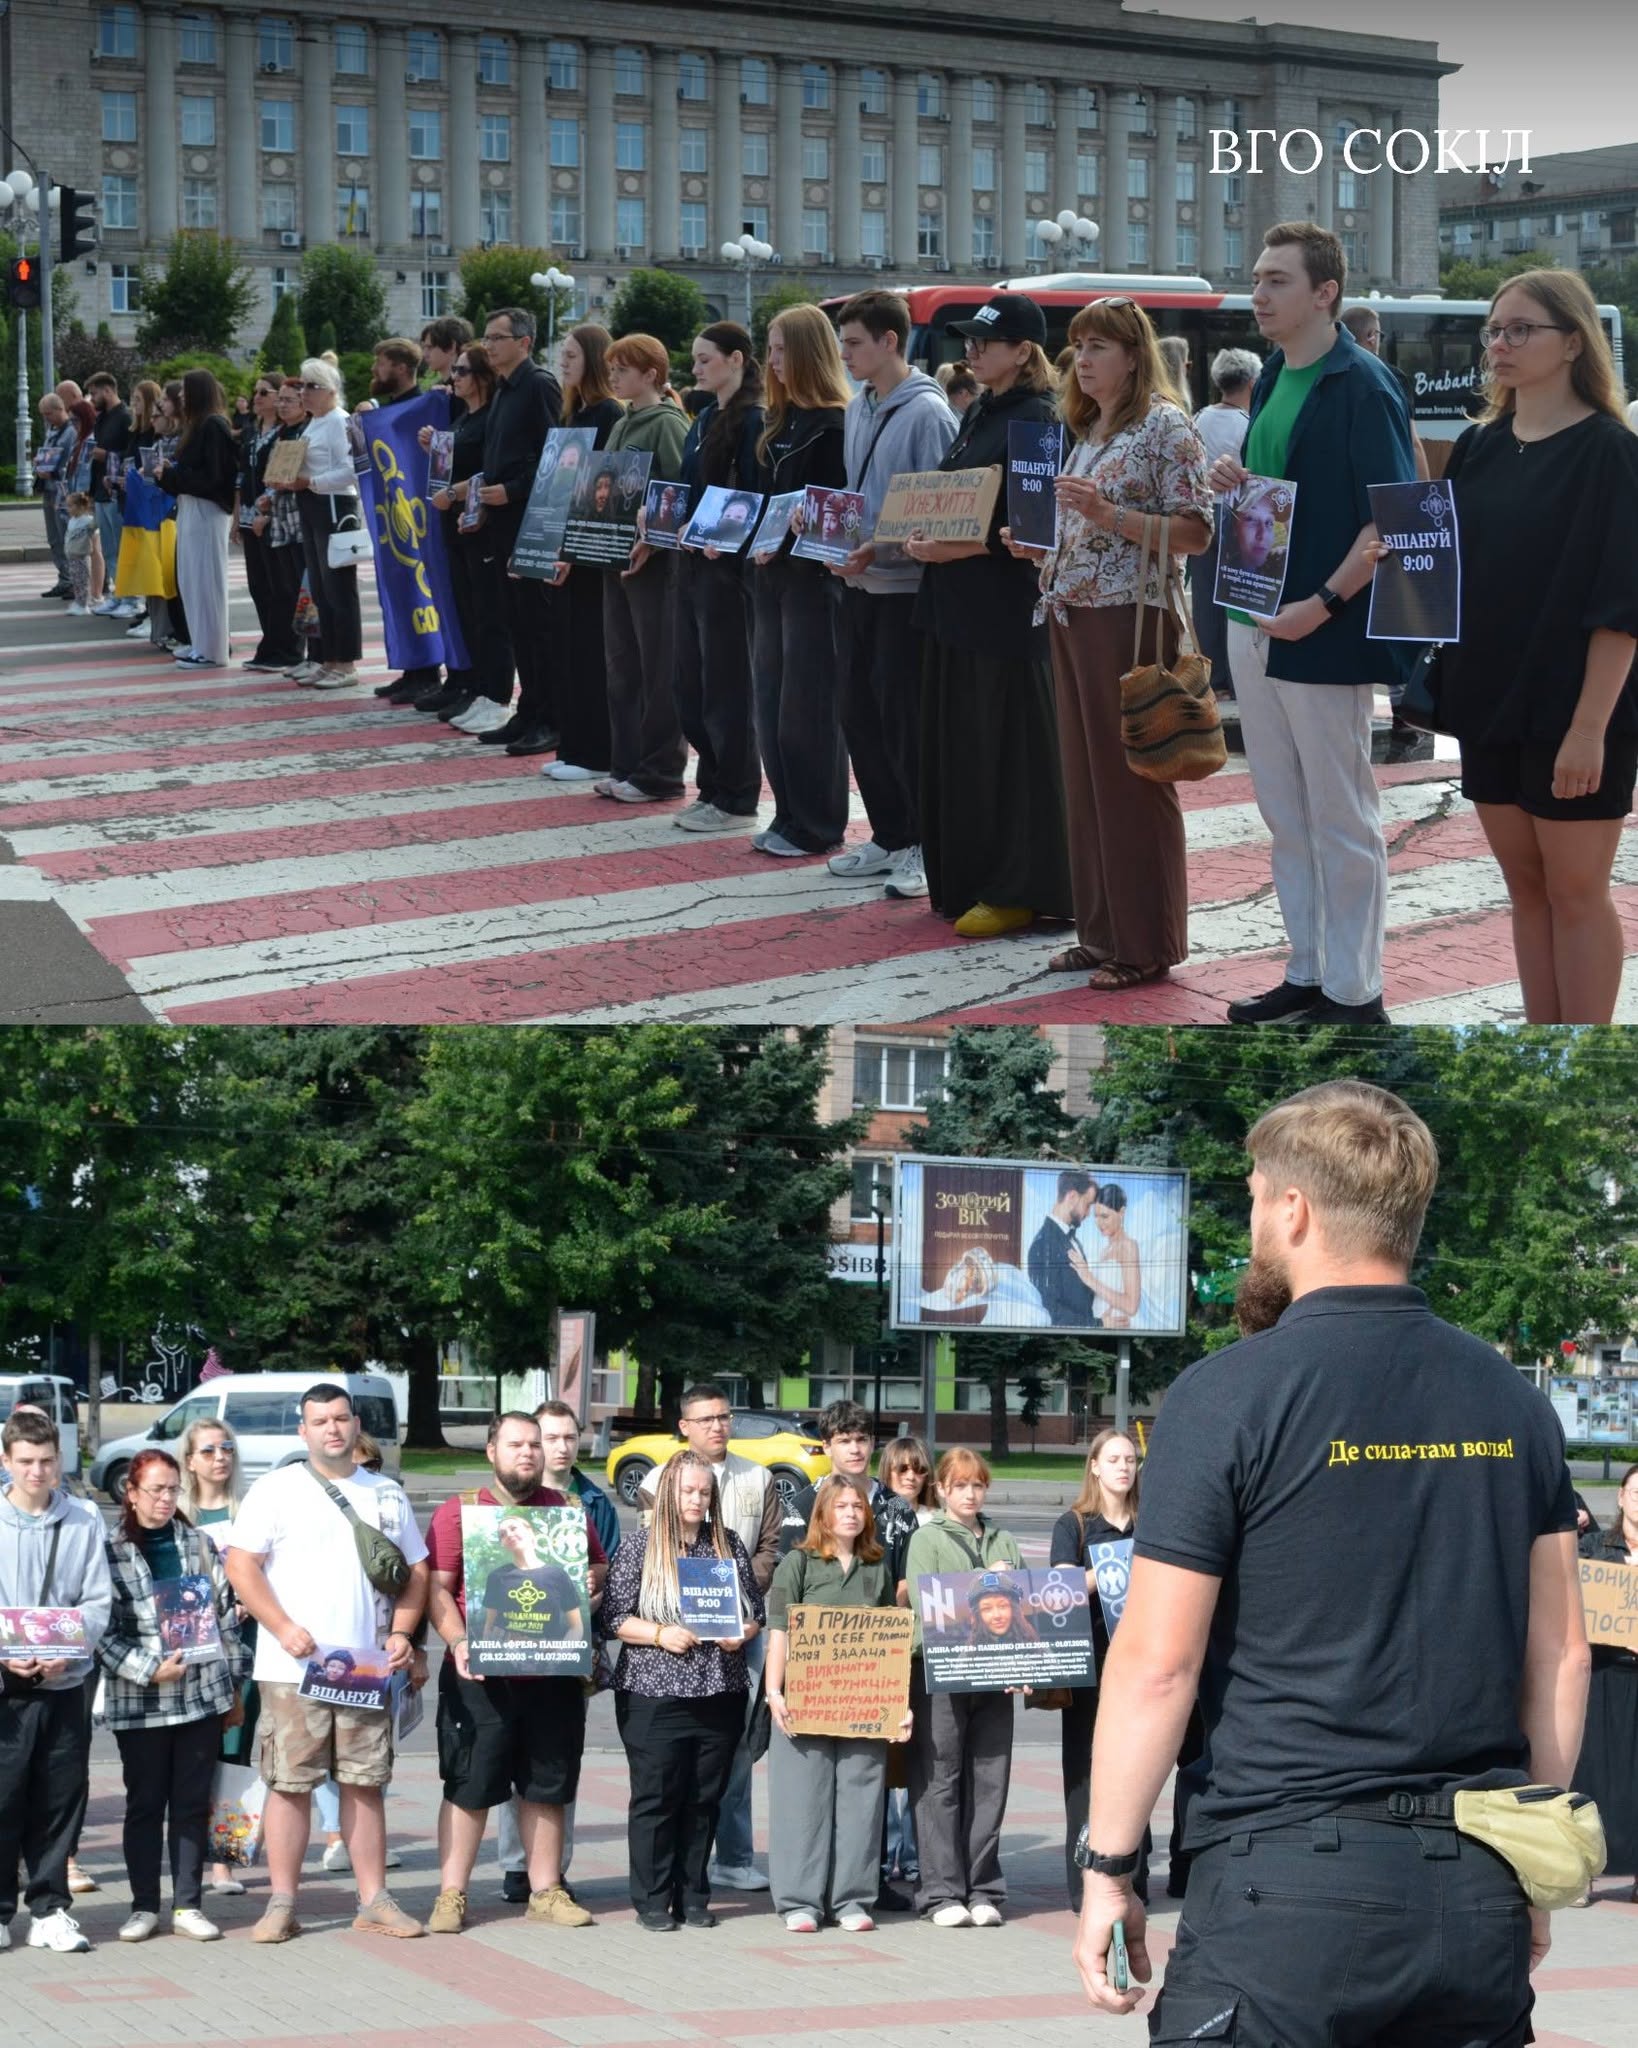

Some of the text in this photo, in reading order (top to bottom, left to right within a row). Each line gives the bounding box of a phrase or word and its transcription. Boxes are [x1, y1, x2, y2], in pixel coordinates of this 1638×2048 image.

[1414, 366, 1476, 396] Brabant
[1011, 460, 1056, 477] ВШАНУЙ
[1022, 478, 1042, 493] 9:00
[1383, 528, 1452, 550] ВШАНУЙ
[1403, 554, 1434, 571] 9:00
[1329, 1438, 1514, 1467] Де сила-там воля!
[682, 1586, 733, 1597] ВШАНУЙ
[697, 1598, 721, 1608] 9:00
[818, 1611, 909, 1630] ПРИЙНЯЛА
[471, 1640, 501, 1649] АЛІНА
[539, 1640, 588, 1650] ПАЩЕНКО
[796, 1633, 826, 1647] ДЛЯ
[832, 1632, 865, 1643] СЕБЕ
[832, 1647, 886, 1661] ЗАДАЧА
[806, 1662, 877, 1678] ВИКОНАТИ
[830, 1676, 900, 1690] ФУНКЦІЮ
[309, 1684, 381, 1705] ВШАНУЙ
[803, 1694, 905, 1707] МАКСИМАЛЬНО
[849, 1722, 882, 1733] ФРЕЯ
